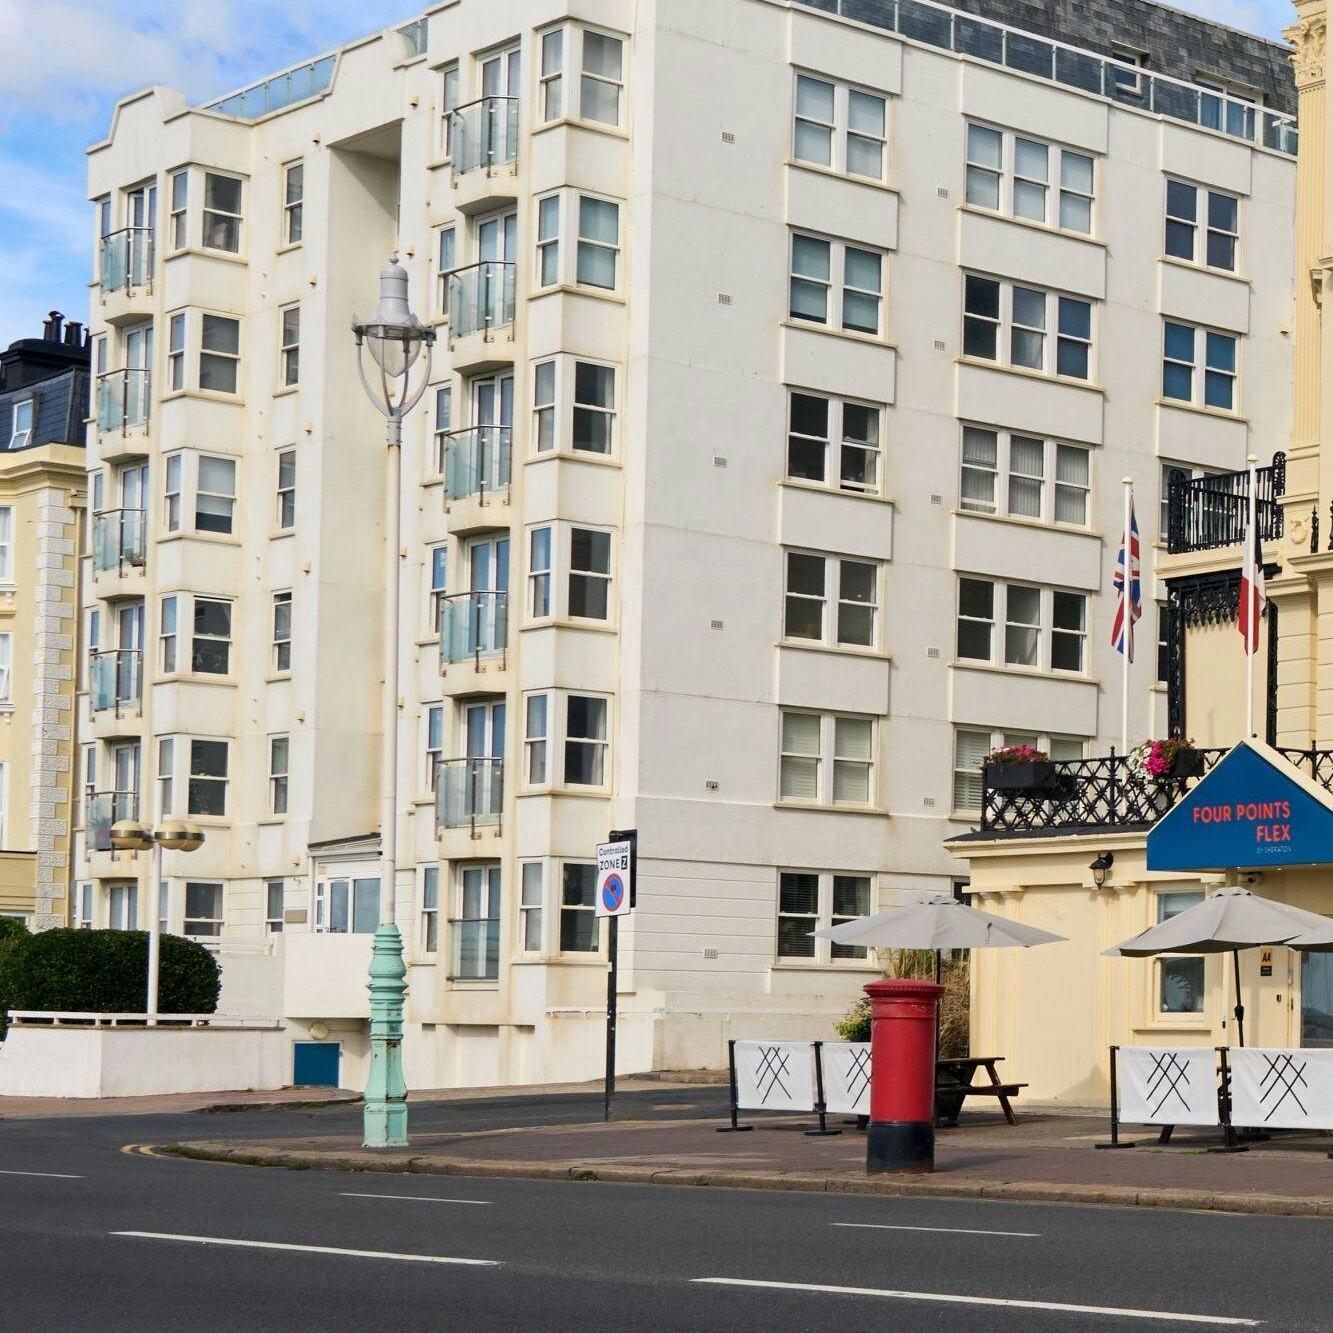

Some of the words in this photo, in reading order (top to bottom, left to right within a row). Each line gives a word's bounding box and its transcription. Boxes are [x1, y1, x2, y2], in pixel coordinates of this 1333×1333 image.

[1193, 805, 1231, 823] FOUR
[1236, 801, 1291, 820] POINTS
[1256, 824, 1291, 842] FLEX
[599, 846, 628, 856] Controlled
[600, 859, 620, 870] ZONE
